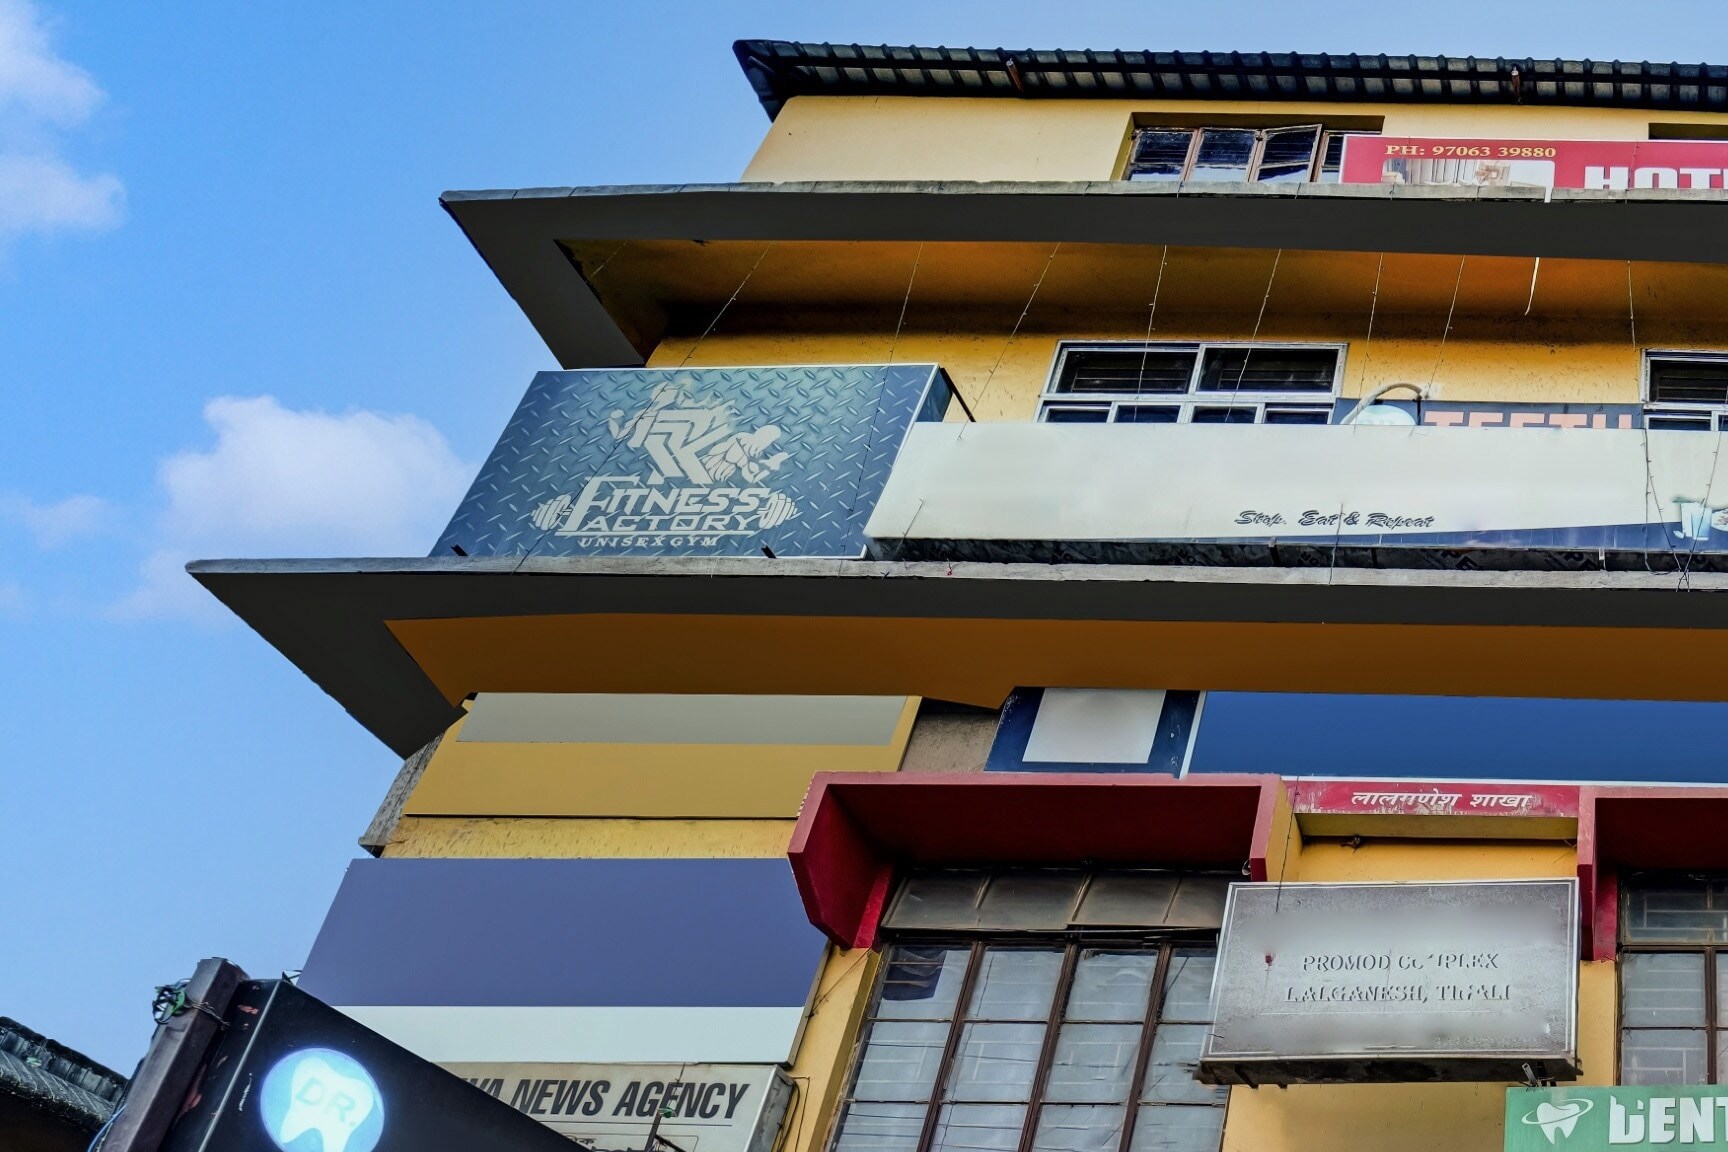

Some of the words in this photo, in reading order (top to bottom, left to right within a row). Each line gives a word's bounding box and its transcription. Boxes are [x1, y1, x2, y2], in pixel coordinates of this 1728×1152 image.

[1385, 144, 1425, 156] PH:
[1432, 146, 1491, 157] 97063
[1497, 147, 1556, 158] 39880
[557, 476, 771, 532] FITNESS
[1298, 509, 1341, 526] Eat
[1343, 511, 1360, 526] &
[1365, 512, 1434, 530] Repeat
[578, 537, 665, 548] UNISEX
[669, 537, 720, 547] GYM
[1470, 793, 1533, 809] शाखा
[511, 1079, 611, 1116] NEWS
[612, 1081, 750, 1119] AGENCY
